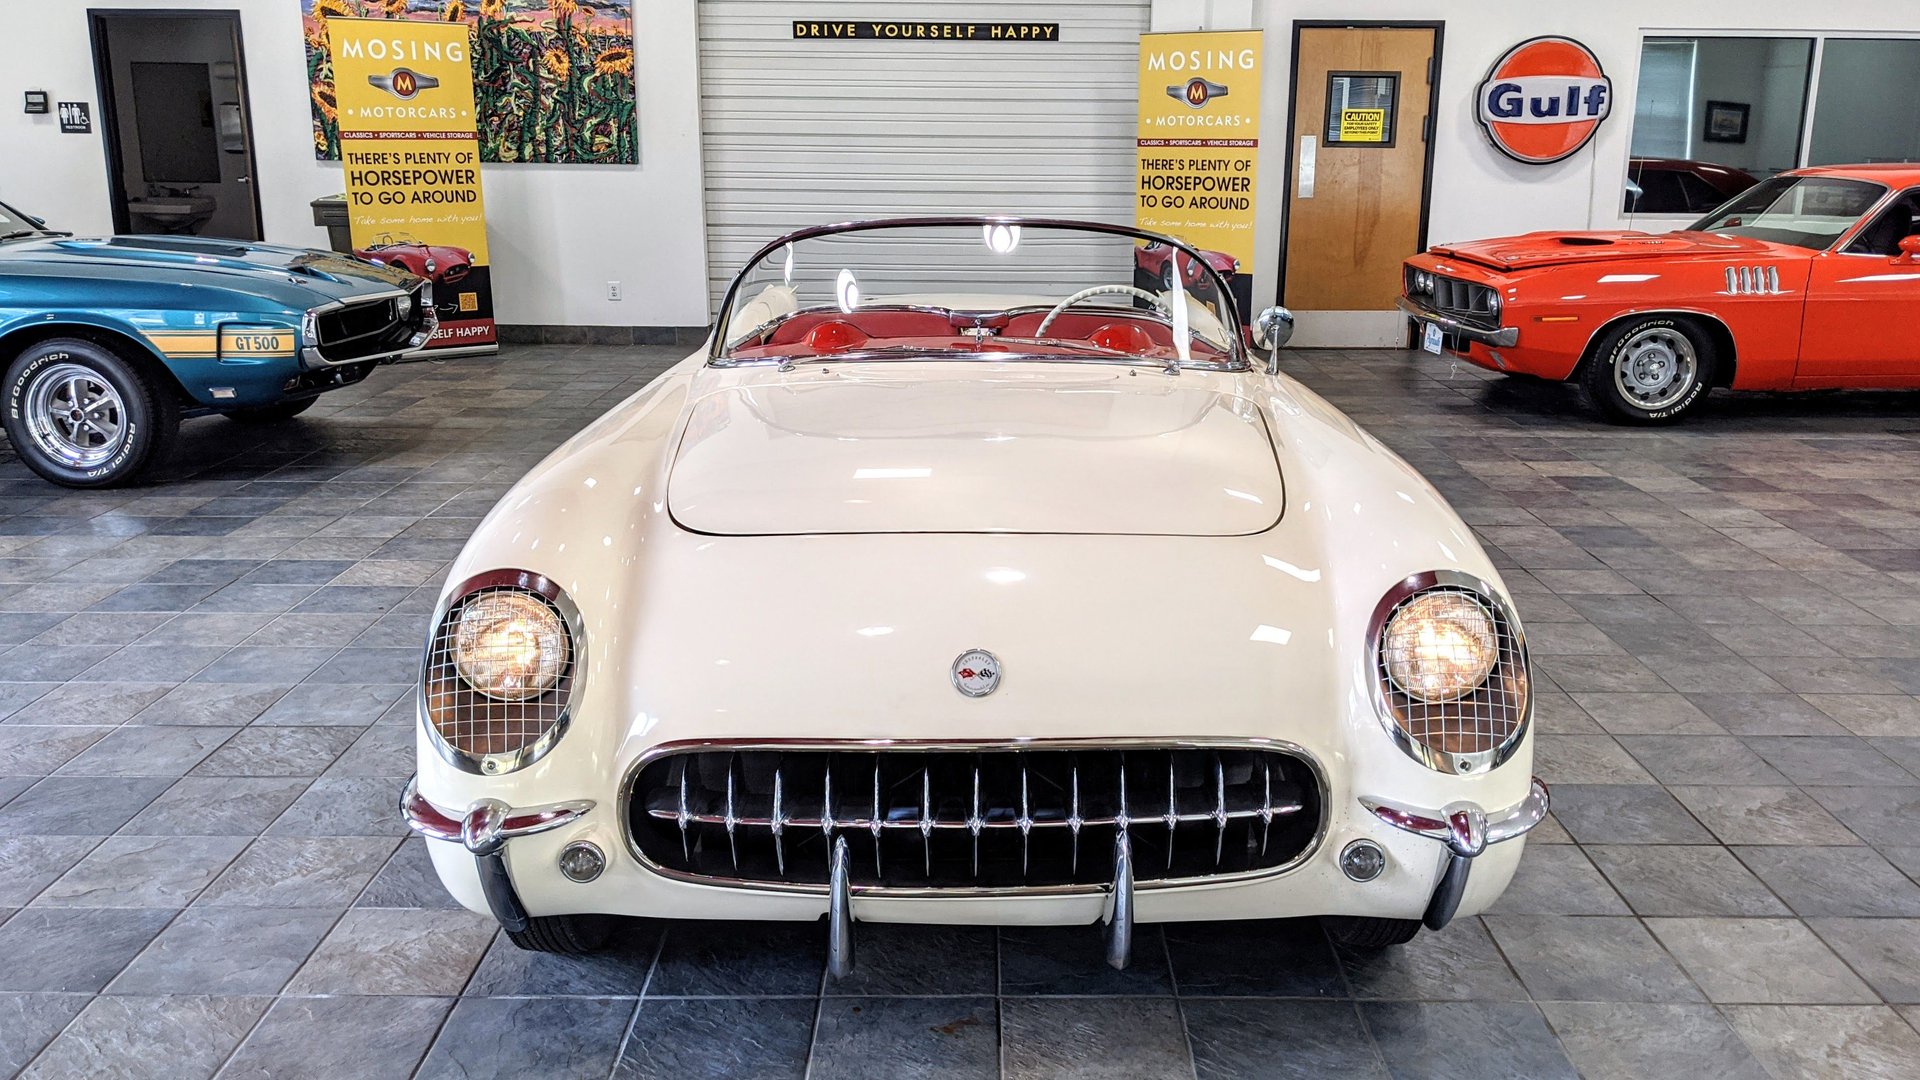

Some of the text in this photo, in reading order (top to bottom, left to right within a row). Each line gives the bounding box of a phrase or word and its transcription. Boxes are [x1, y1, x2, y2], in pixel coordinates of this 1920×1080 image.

[796, 24, 1054, 38] DRIVE YOURSELF HAPPY
[342, 38, 463, 62] MOSING
[1148, 49, 1254, 71] MOSING
[396, 76, 412, 91] M
[1190, 85, 1204, 100] M
[1488, 83, 1606, 118] Gulf
[360, 106, 456, 118] MOTORCARS
[1156, 115, 1240, 126] MOTORCARS
[348, 152, 473, 164] THERE'S PLENTY OF
[1141, 159, 1251, 171] THERE'S PLENTY OF
[351, 170, 475, 186] HORSEPOWER
[1141, 176, 1250, 192] HORSEPOWER
[352, 190, 476, 205] TO GO AROUND
[1140, 195, 1249, 210] TO GO AROUND
[354, 216, 376, 225] Take
[409, 216, 433, 224] home
[461, 212, 482, 224] you!
[1140, 217, 1156, 226] Take
[1184, 219, 1206, 227] home
[1232, 222, 1252, 231] you!
[456, 326, 490, 337] HAPPY
[1609, 320, 1674, 364] BFGoodrich
[11, 353, 69, 419] BFGoodrich
[1671, 382, 1702, 414] Radial
[87, 423, 136, 477] Radial T/A
